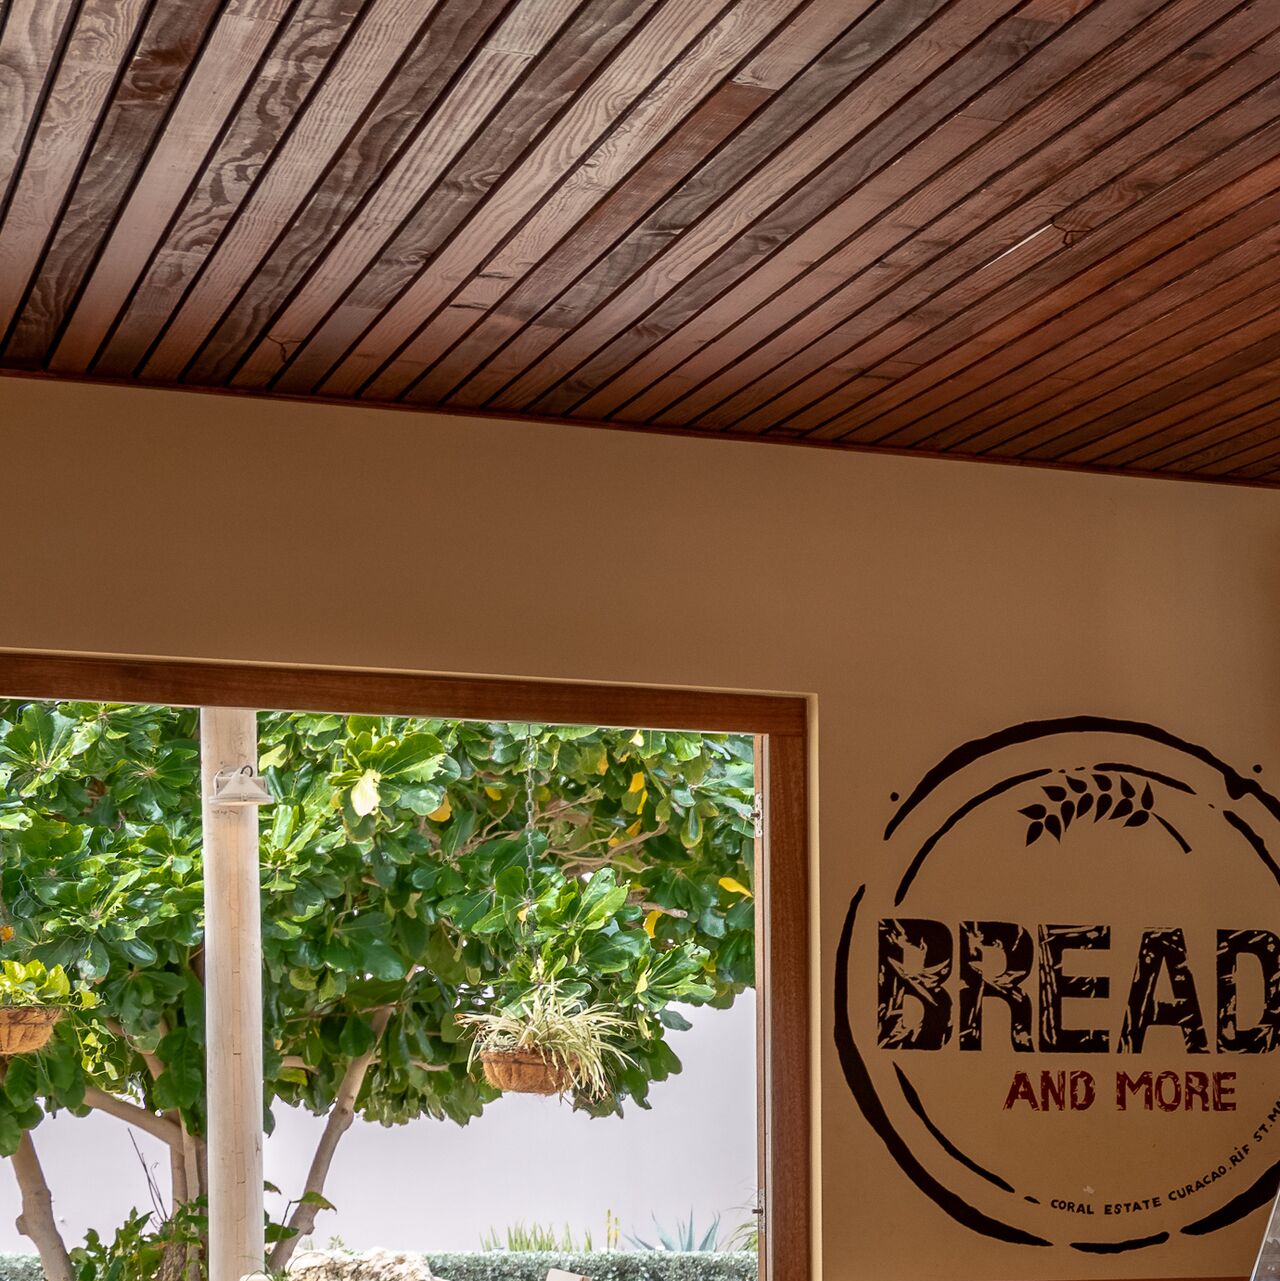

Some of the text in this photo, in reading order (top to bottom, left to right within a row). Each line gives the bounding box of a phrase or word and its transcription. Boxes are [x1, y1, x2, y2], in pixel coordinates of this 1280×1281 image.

[1002, 1070, 1237, 1112] AND MORE
[1050, 1198, 1095, 1215] CORAL
[1103, 1196, 1162, 1216] ESTATE
